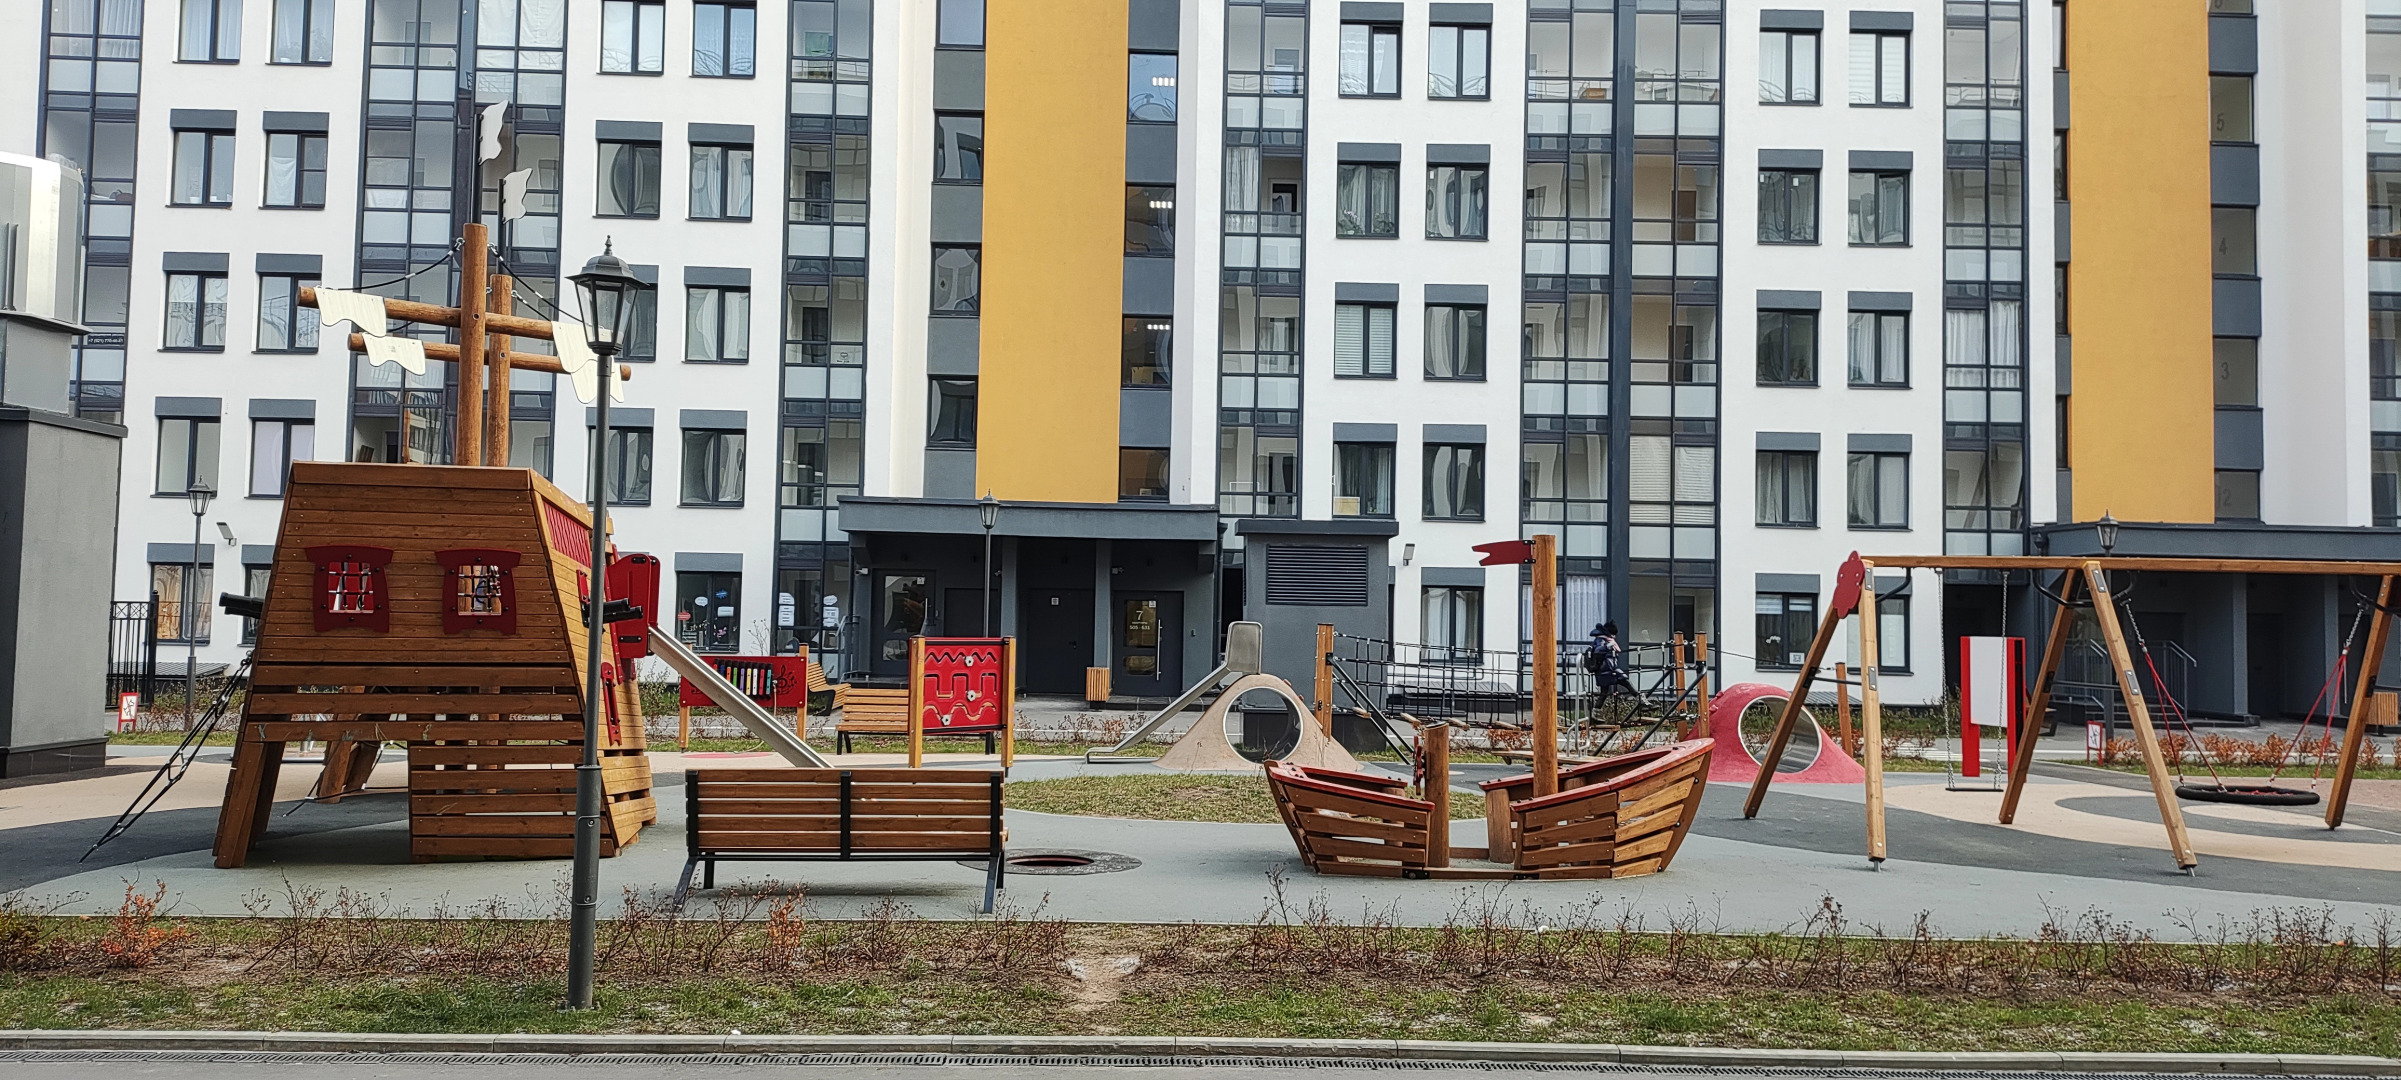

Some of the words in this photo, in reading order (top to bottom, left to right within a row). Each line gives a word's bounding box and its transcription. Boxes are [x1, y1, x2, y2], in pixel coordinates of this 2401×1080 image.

[2216, 112, 2225, 131] 5
[2218, 237, 2227, 255] 4
[2221, 361, 2229, 380] 3
[2222, 488, 2231, 506] 2
[1136, 610, 1144, 620] 7
